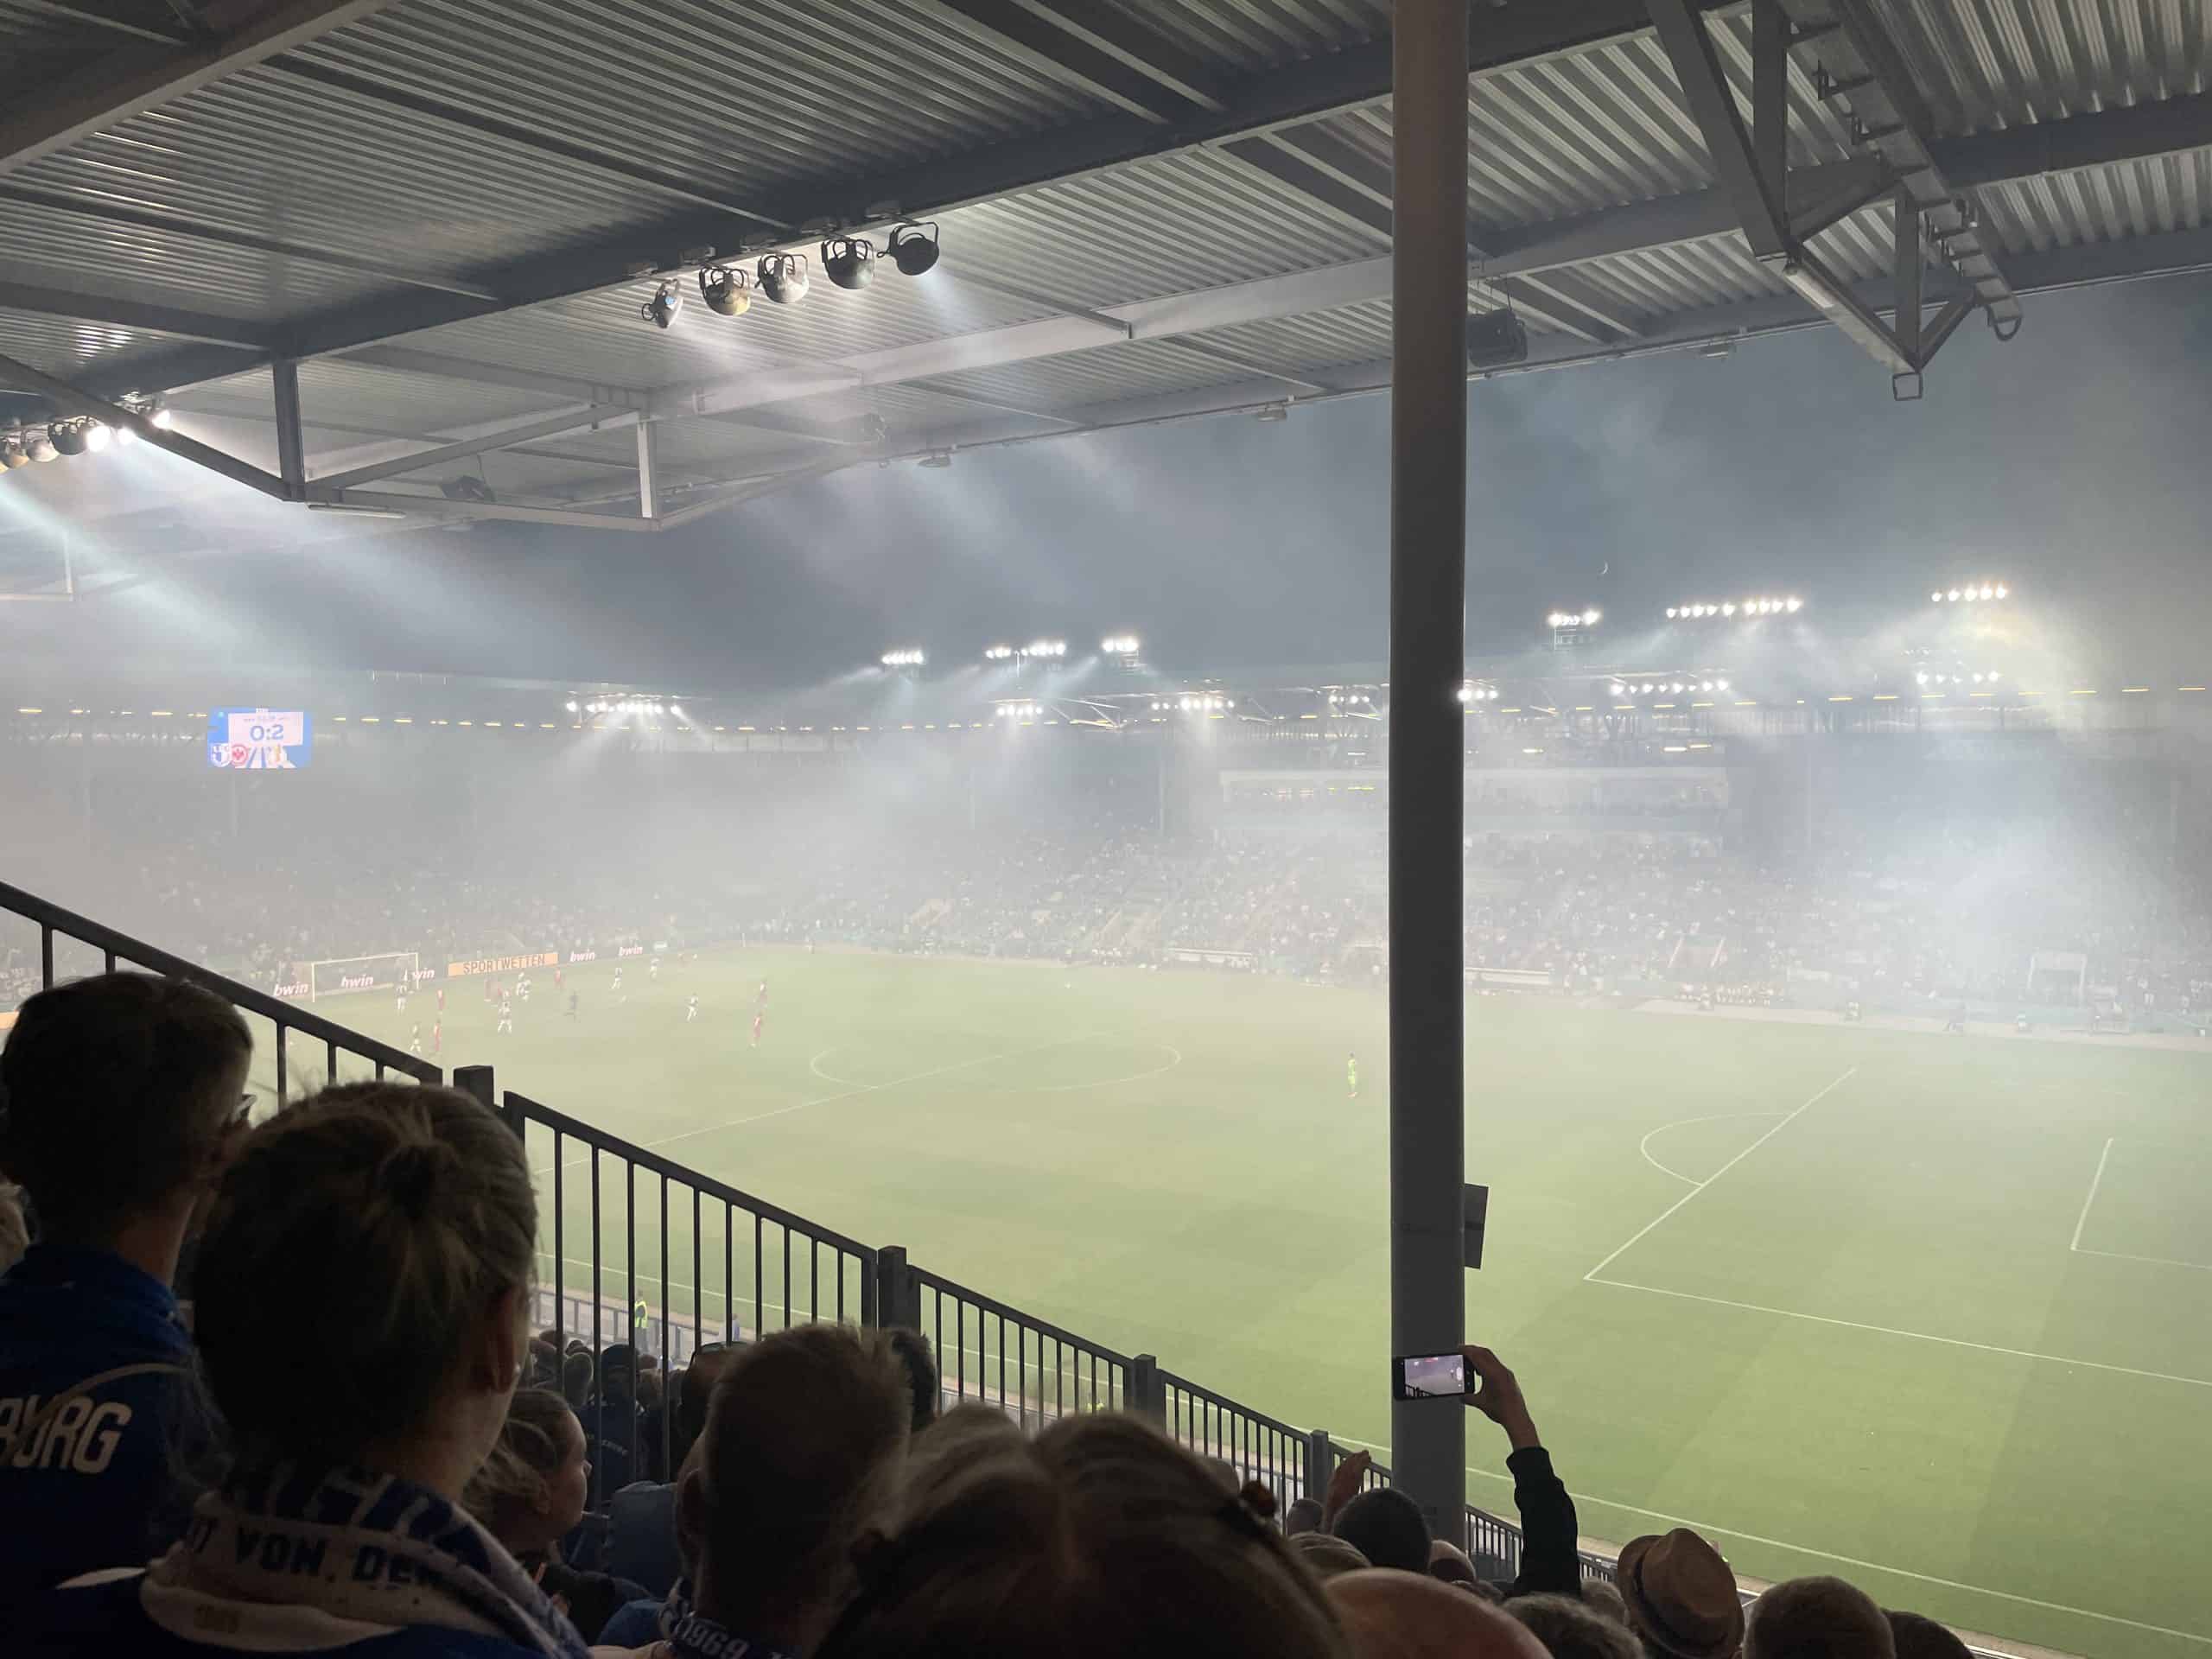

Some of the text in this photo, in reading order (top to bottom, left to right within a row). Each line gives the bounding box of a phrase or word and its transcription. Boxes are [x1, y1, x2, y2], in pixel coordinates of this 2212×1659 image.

[250, 725, 283, 741] 0:2
[570, 950, 595, 963] bwin
[618, 945, 643, 957] bwin
[272, 981, 309, 997] bwin
